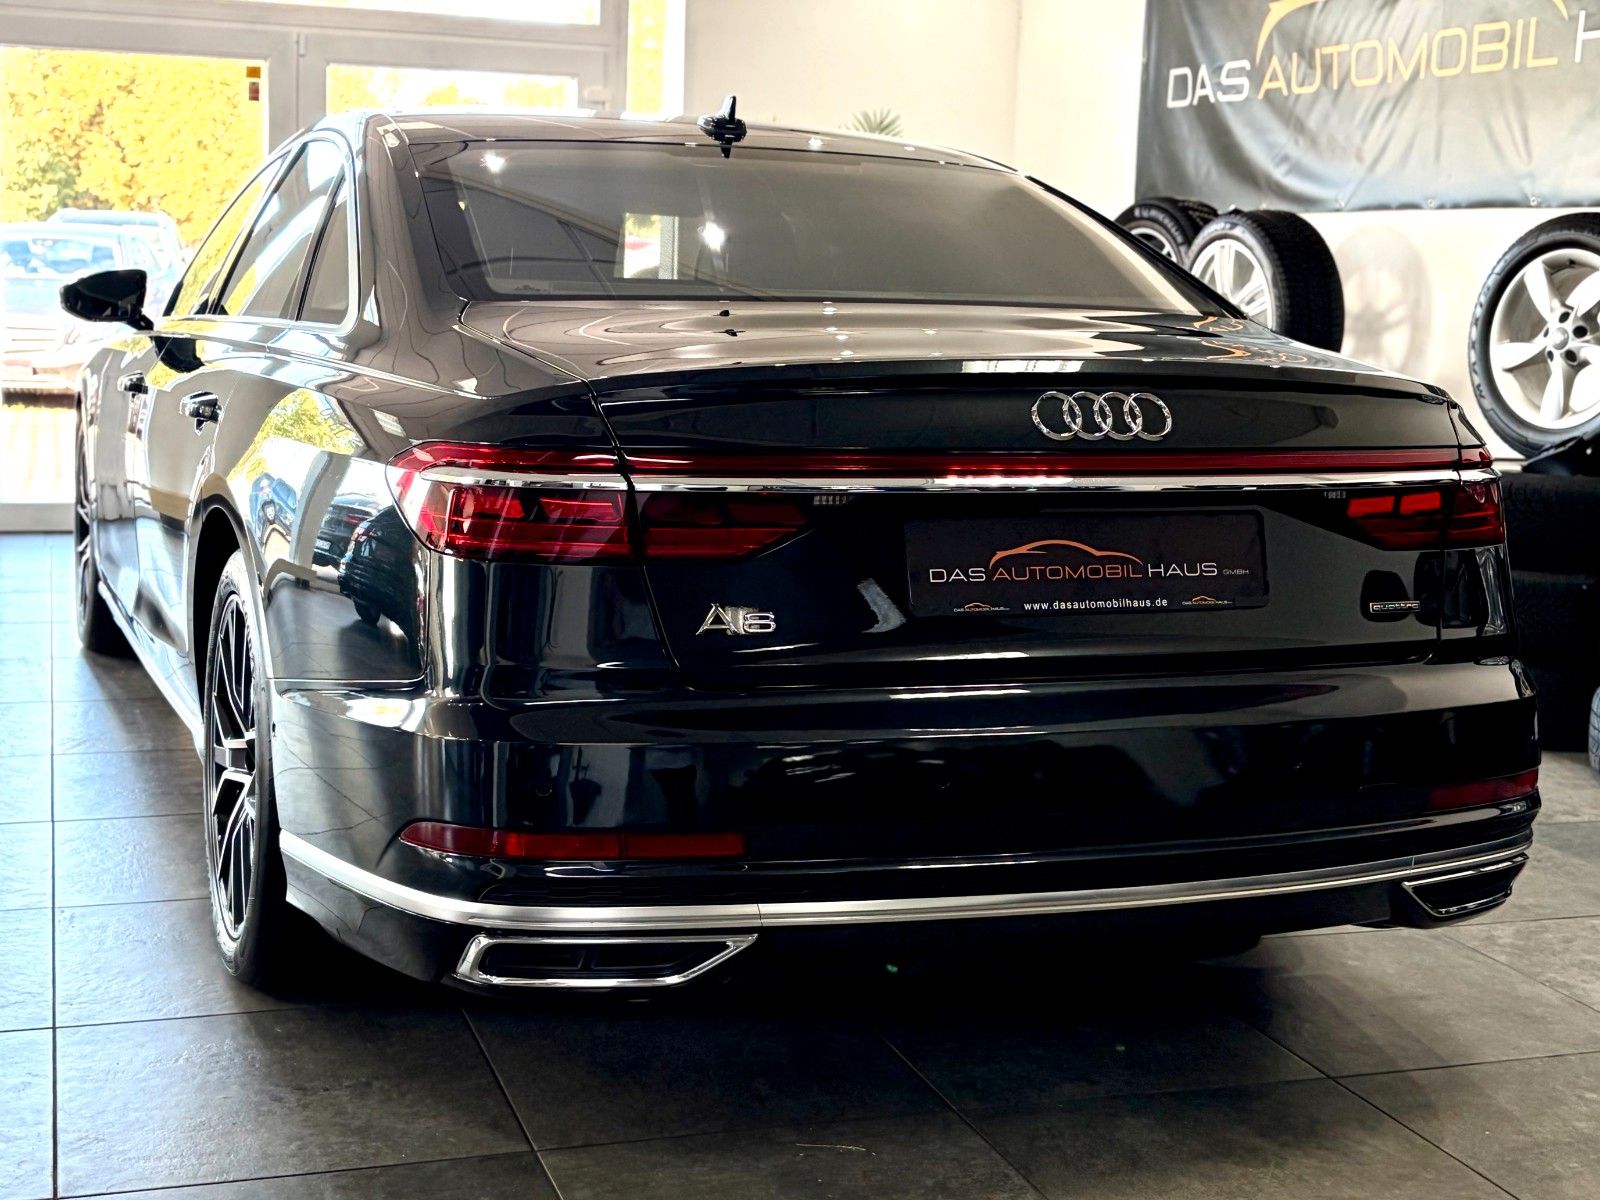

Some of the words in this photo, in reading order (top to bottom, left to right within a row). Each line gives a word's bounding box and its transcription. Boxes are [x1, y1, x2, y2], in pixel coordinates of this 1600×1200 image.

[1166, 59, 1251, 108] DAS
[1257, 16, 1558, 100] AUTOMOBIL
[929, 568, 986, 583] DAS
[992, 564, 1143, 582] AUTOMOBIL
[1147, 562, 1218, 577] HAUS
[1023, 597, 1168, 611] www.dasautomobilhaus.de
